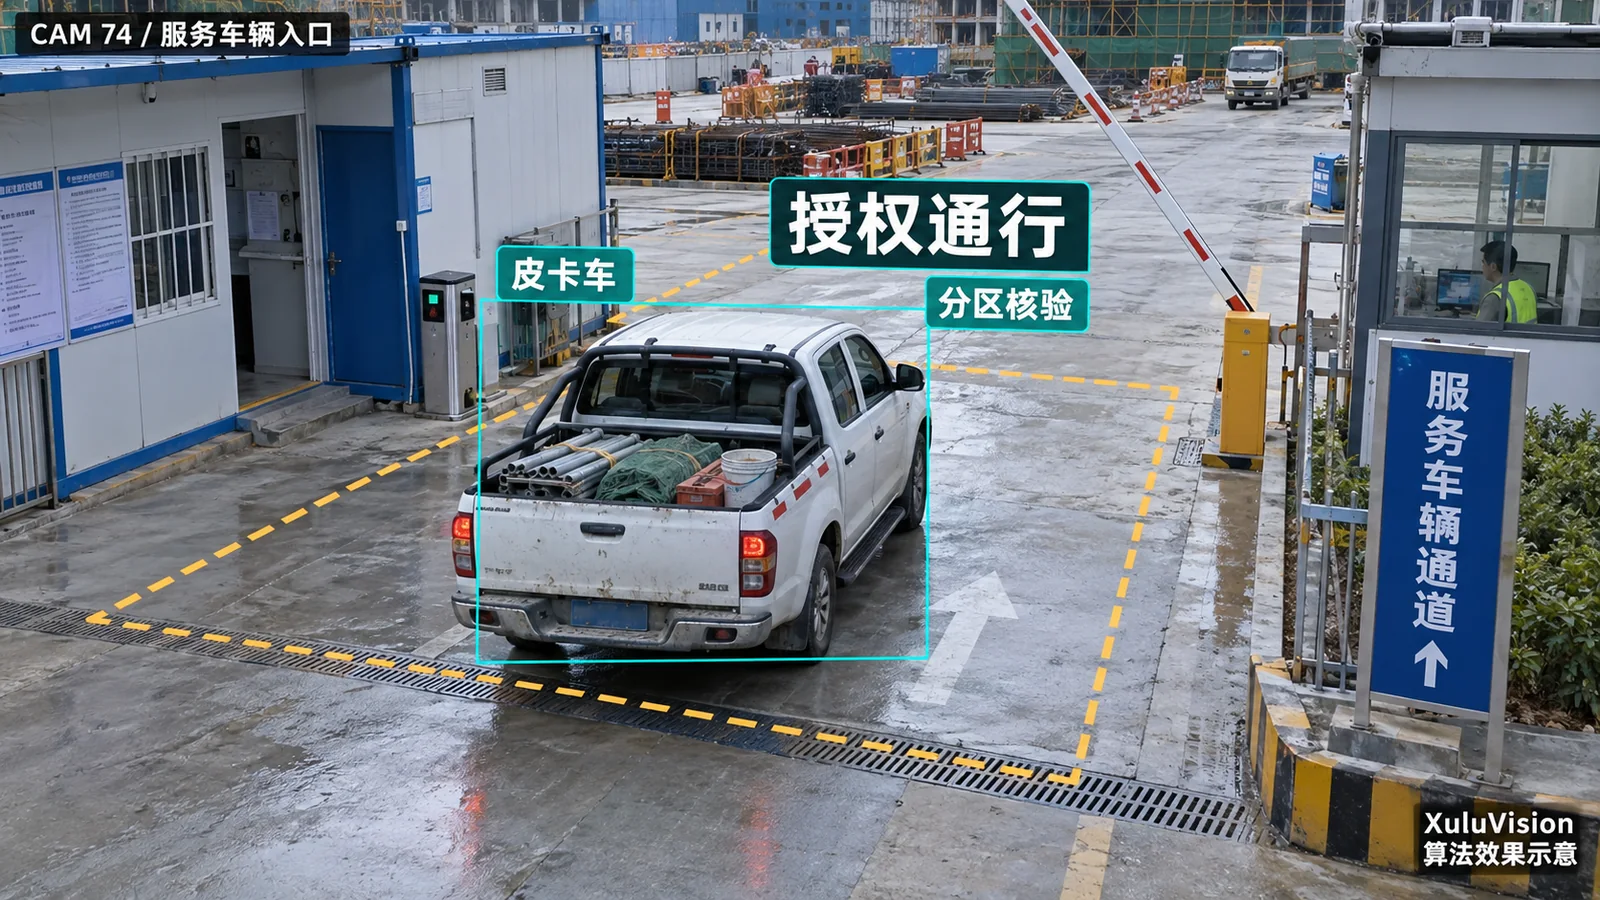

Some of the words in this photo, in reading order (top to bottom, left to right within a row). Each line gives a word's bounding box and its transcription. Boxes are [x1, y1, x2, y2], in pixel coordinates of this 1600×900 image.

[1412, 370, 1469, 633] 服务车辆通道
